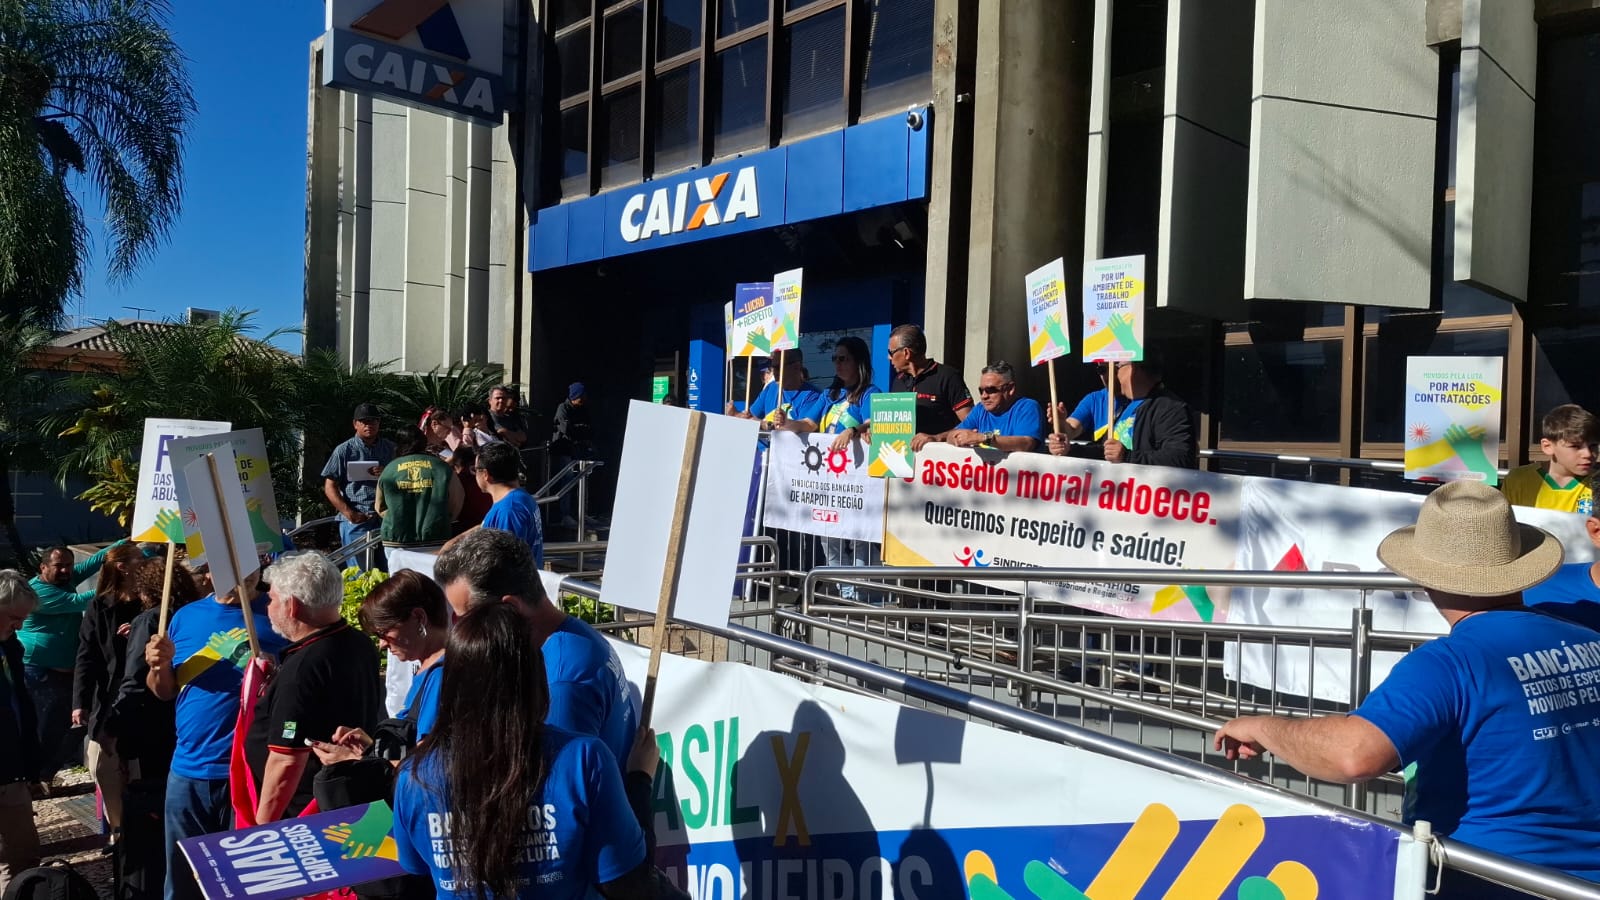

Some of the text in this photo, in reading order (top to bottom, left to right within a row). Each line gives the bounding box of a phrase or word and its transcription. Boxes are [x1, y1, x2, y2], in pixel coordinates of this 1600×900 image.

[344, 43, 494, 113] CAIXA
[621, 166, 759, 242] CAIXA
[1101, 272, 1124, 281] POR UM
[1093, 281, 1134, 292] AMBIENTE DE
[1096, 291, 1129, 300] TRABALHO
[744, 296, 765, 313] LUCRO
[744, 307, 773, 327] RESPEITO
[1430, 382, 1475, 392] POR MAIS
[874, 411, 912, 422] LUTAR PARA
[873, 423, 912, 434] CONQUISTAR
[240, 459, 254, 469] DE
[153, 473, 172, 486] DAS
[792, 479, 819, 490] SINDICATO
[820, 483, 830, 491] DOS
[152, 487, 178, 501] ABUS
[790, 490, 863, 510] DE ARAPOTI E REGIÃO
[922, 456, 1217, 526] assédio moral adoece.
[814, 510, 838, 522] CUT
[925, 501, 1186, 567] Queremos respeito e saúde!
[1507, 641, 1600, 681] BANCÁRIO
[1522, 669, 1600, 698] FEITOS DE ESPE
[1528, 686, 1600, 715] MOVIDOS PEL
[652, 716, 759, 830] ASIL
[770, 732, 811, 846] X
[219, 830, 308, 895] MAIS
[282, 824, 339, 882] EMPREGOS
[526, 845, 560, 863] LUTA
